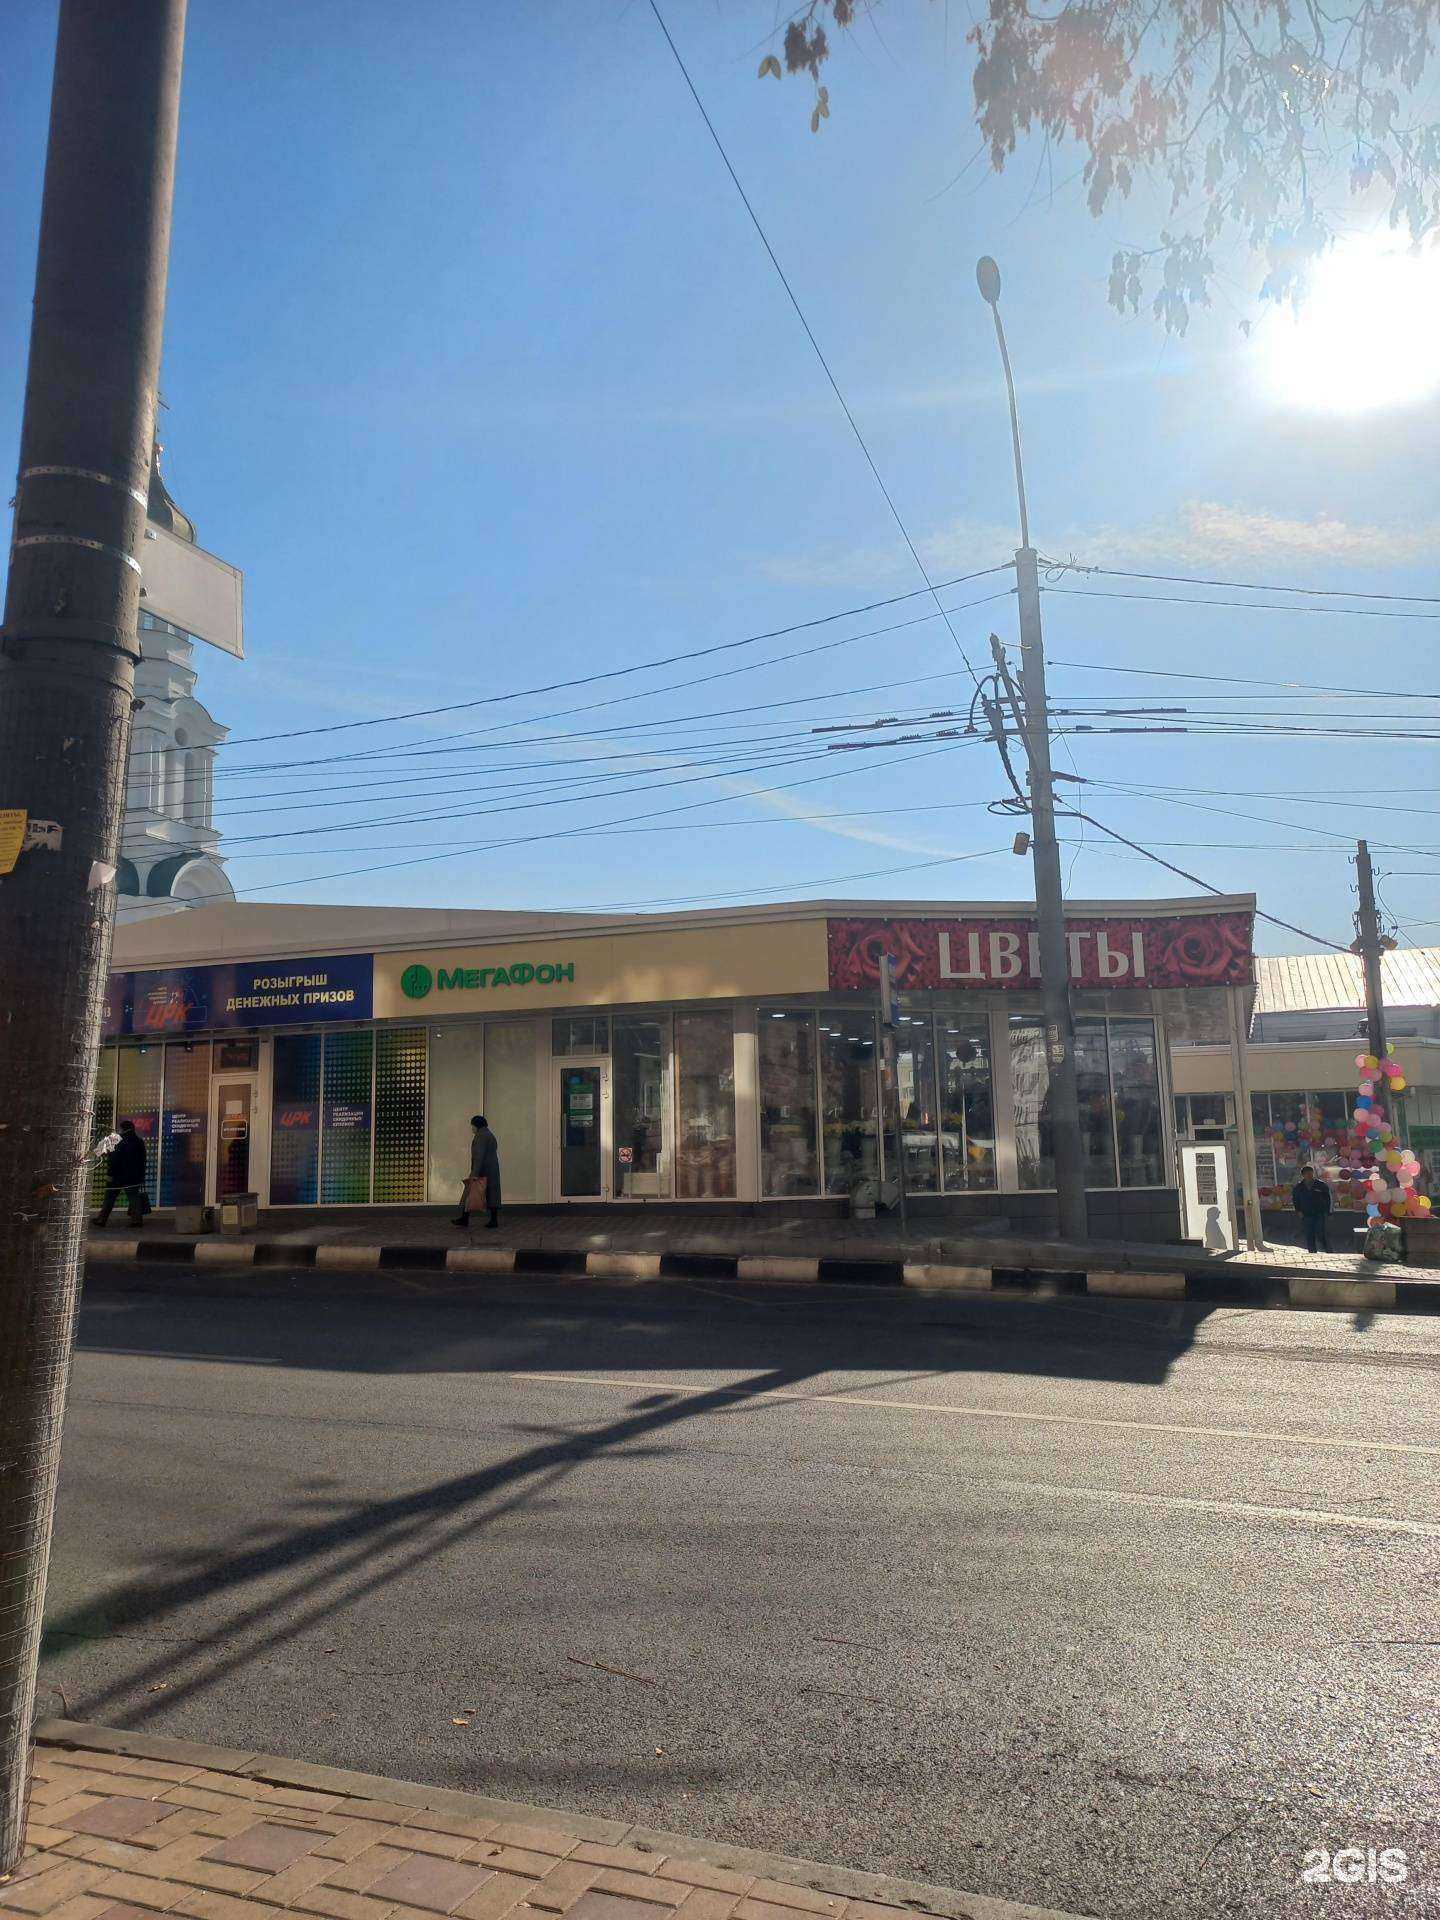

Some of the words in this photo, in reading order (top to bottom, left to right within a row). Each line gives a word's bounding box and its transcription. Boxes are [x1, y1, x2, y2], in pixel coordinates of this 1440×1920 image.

[253, 974, 328, 990] РОЗЫГРЫШ
[226, 993, 300, 1012] ДЕНЕЖНЫХ
[303, 989, 355, 1004] ПРИЗОВ
